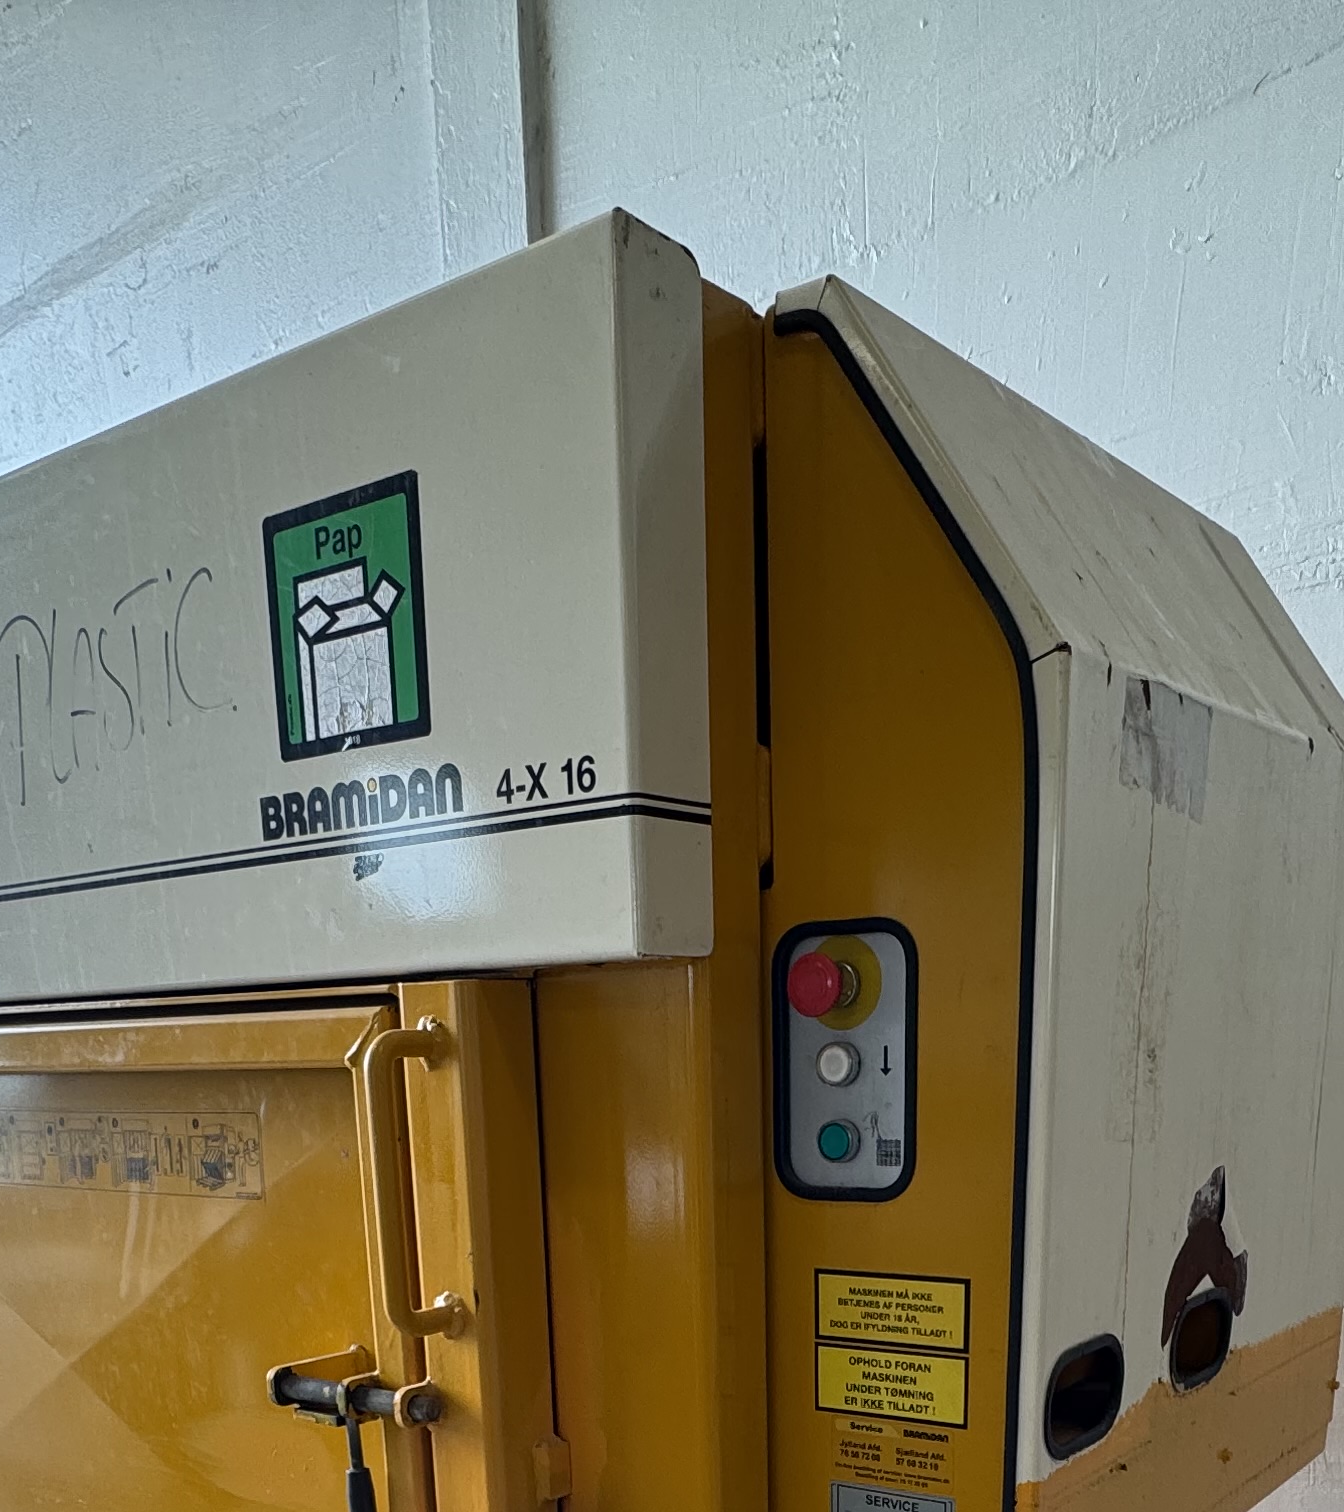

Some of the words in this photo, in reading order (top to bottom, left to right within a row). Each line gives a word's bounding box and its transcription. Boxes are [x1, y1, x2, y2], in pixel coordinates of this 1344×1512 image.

[314, 522, 363, 561] Pap
[495, 761, 549, 805] 4-X
[560, 754, 597, 796] 16
[849, 1287, 894, 1298] MASKINEN
[895, 1288, 910, 1300] MÅ
[912, 1292, 933, 1301] IKKE
[838, 1297, 881, 1309] BETJENES
[882, 1302, 893, 1310] AF
[895, 1303, 944, 1314] PERSONER
[860, 1311, 891, 1321] UNDER
[830, 1319, 848, 1329] DOG
[850, 1322, 862, 1330] ER
[911, 1327, 947, 1338] TILLADT
[848, 1356, 892, 1369] OPHOLD
[894, 1361, 931, 1373] FORAN
[862, 1371, 917, 1386] MASKINEN
[845, 1382, 882, 1395] UNDER
[884, 1386, 934, 1402] TØMNING
[844, 1396, 858, 1406] ER
[860, 1397, 884, 1410] IKKE
[887, 1401, 930, 1415] TILLADT
[849, 1421, 883, 1434] Service
[865, 1494, 919, 1512] SERVICE
